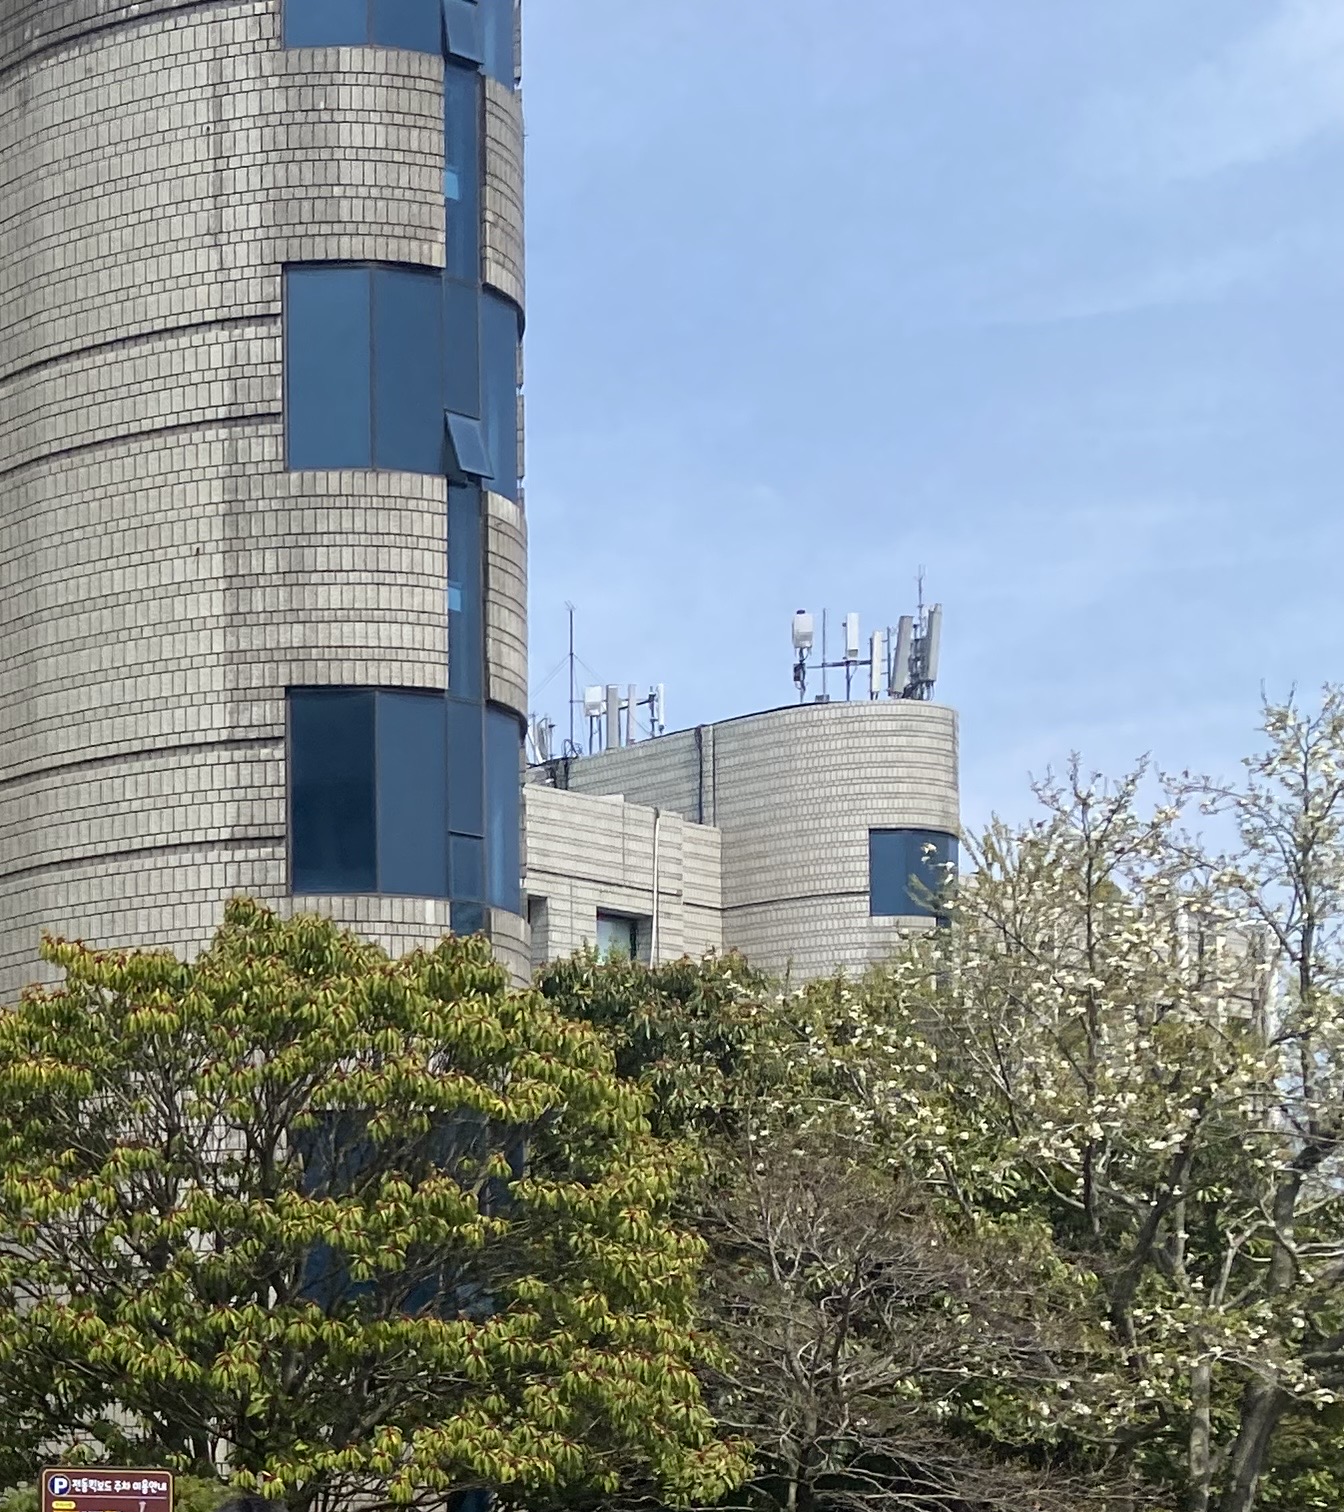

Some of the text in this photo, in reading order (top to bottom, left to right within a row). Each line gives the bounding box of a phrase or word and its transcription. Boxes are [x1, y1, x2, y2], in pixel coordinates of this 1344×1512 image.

[54, 1478, 68, 1494] P
[72, 1478, 167, 1494] 전동킥보드 주차 이용안내
